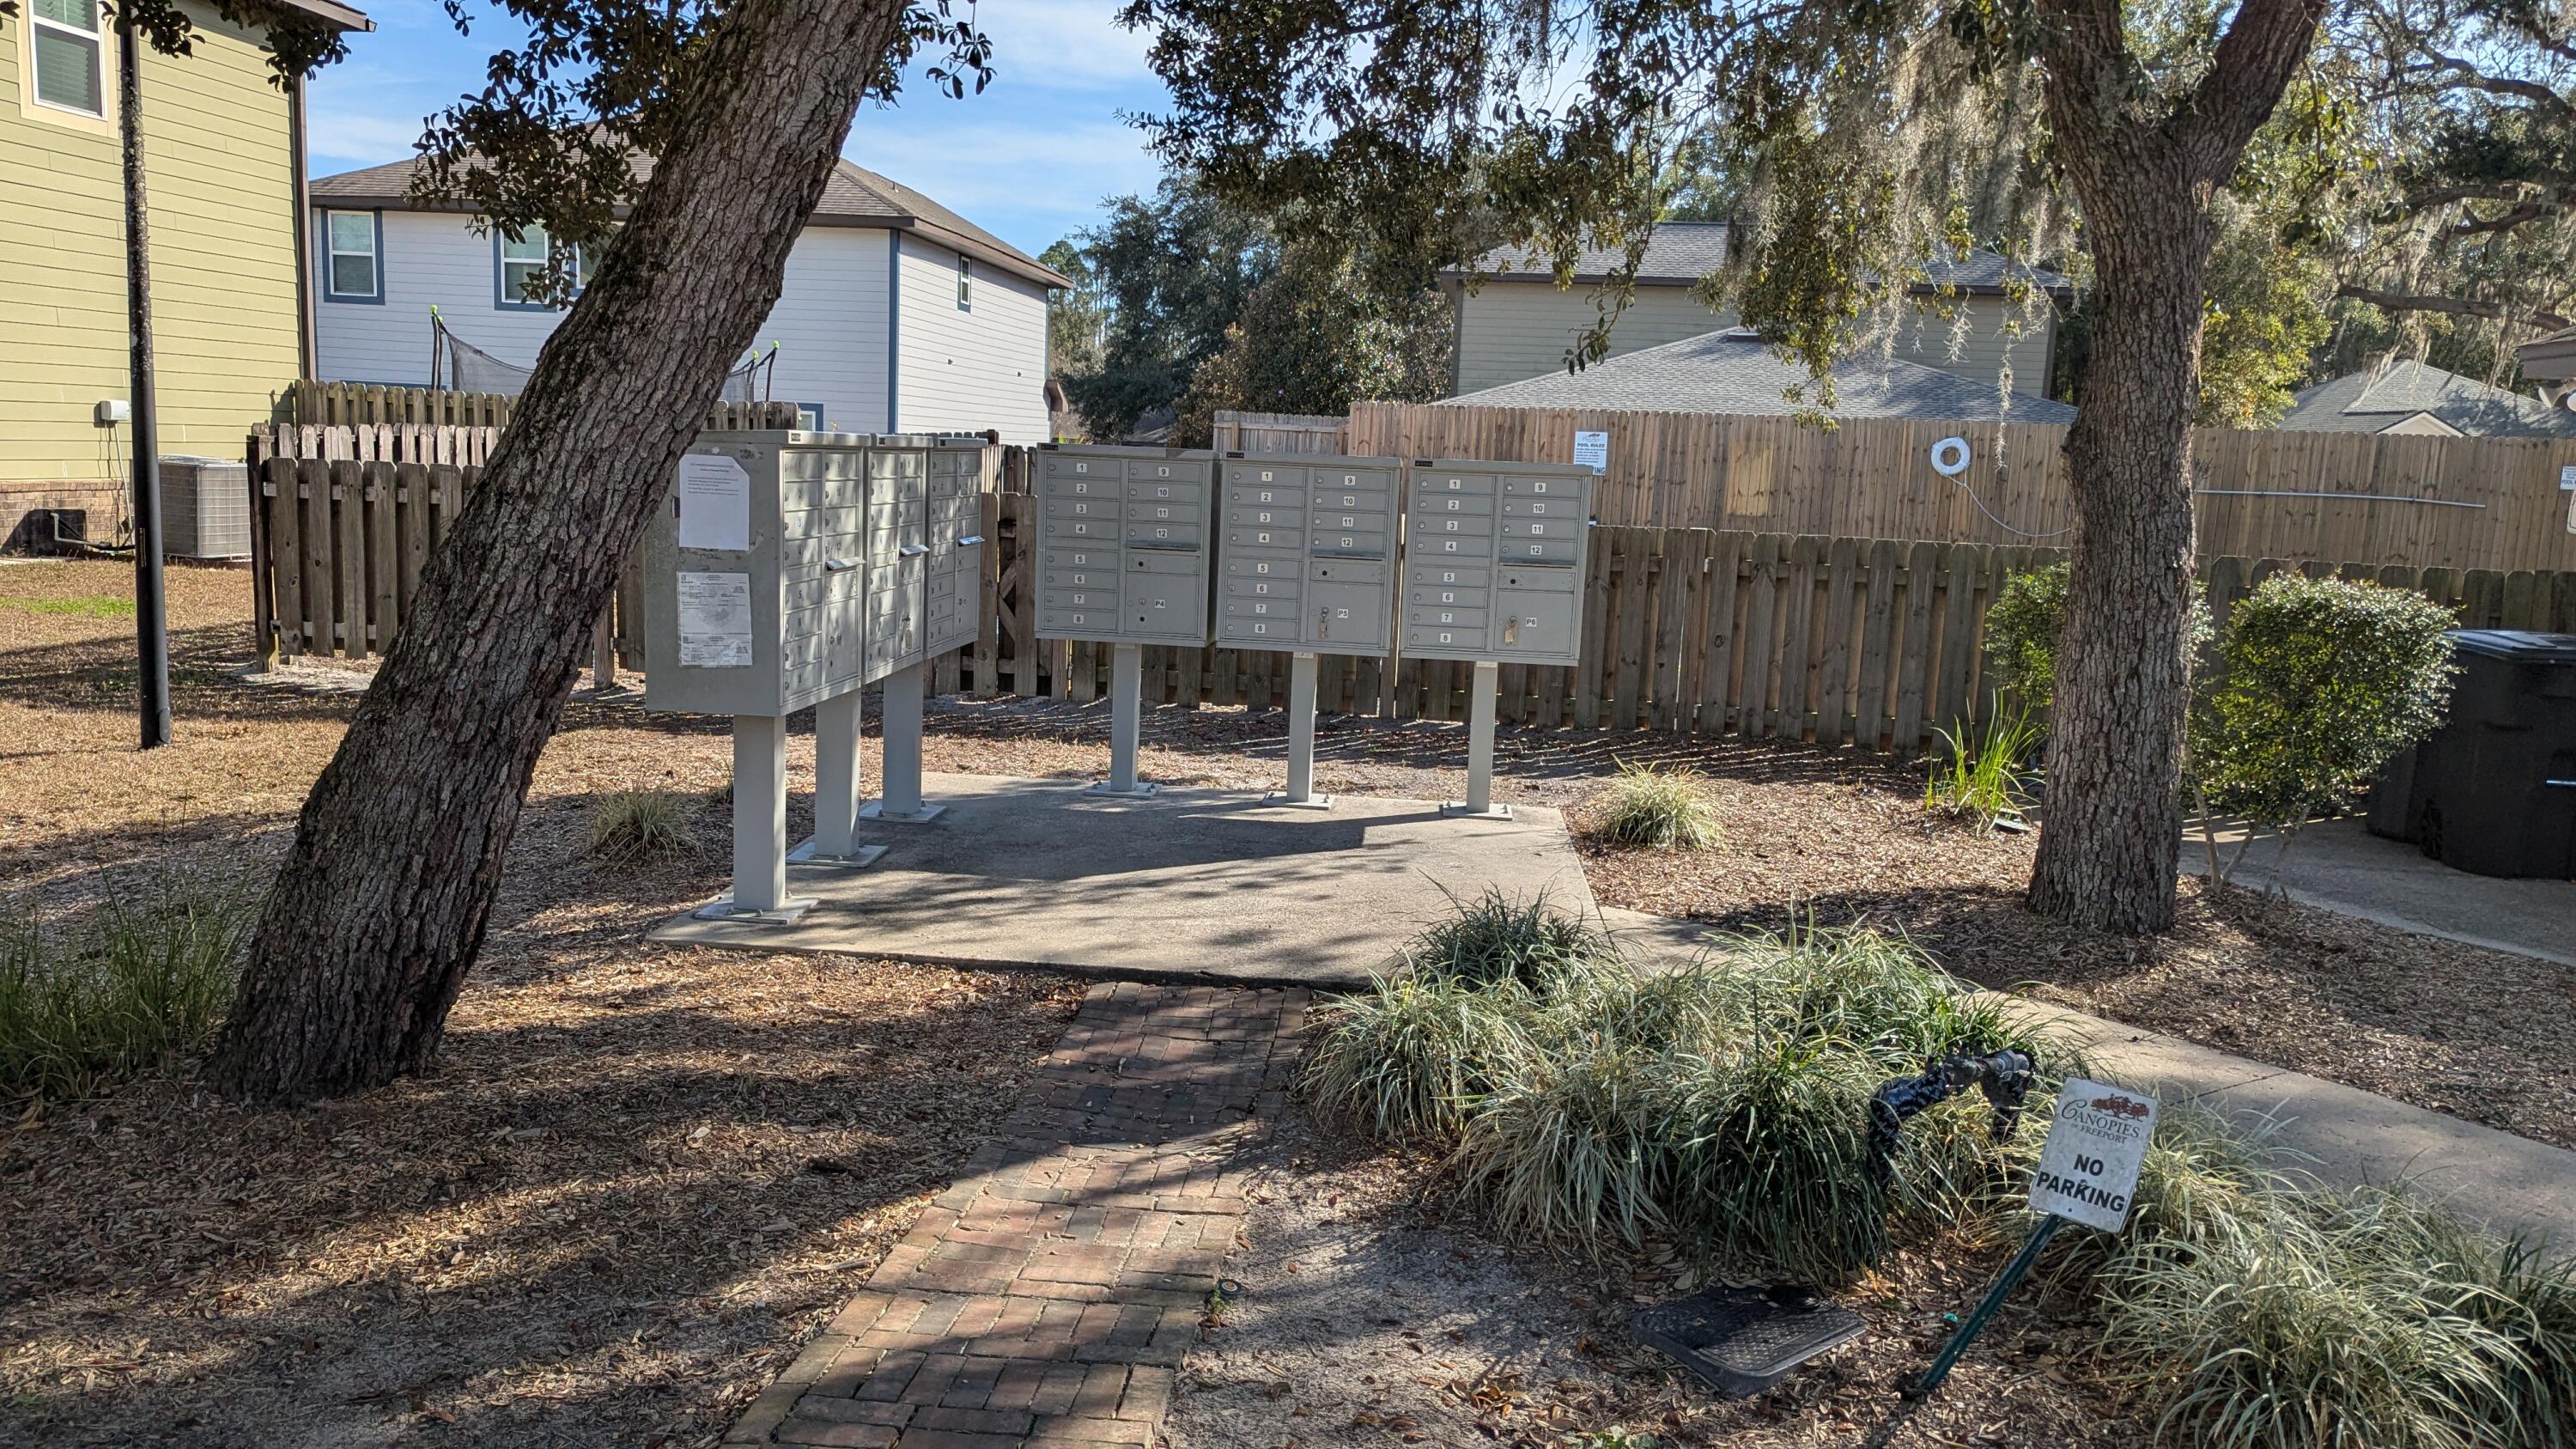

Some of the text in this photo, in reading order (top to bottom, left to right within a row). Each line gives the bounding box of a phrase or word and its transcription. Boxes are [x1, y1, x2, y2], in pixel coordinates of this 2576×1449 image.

[2061, 1099, 2142, 1138] CANOPIES
[2081, 1124, 2128, 1144] FREEPORT
[2073, 1154, 2104, 1176] NO
[2036, 1171, 2125, 1213] PARKING
